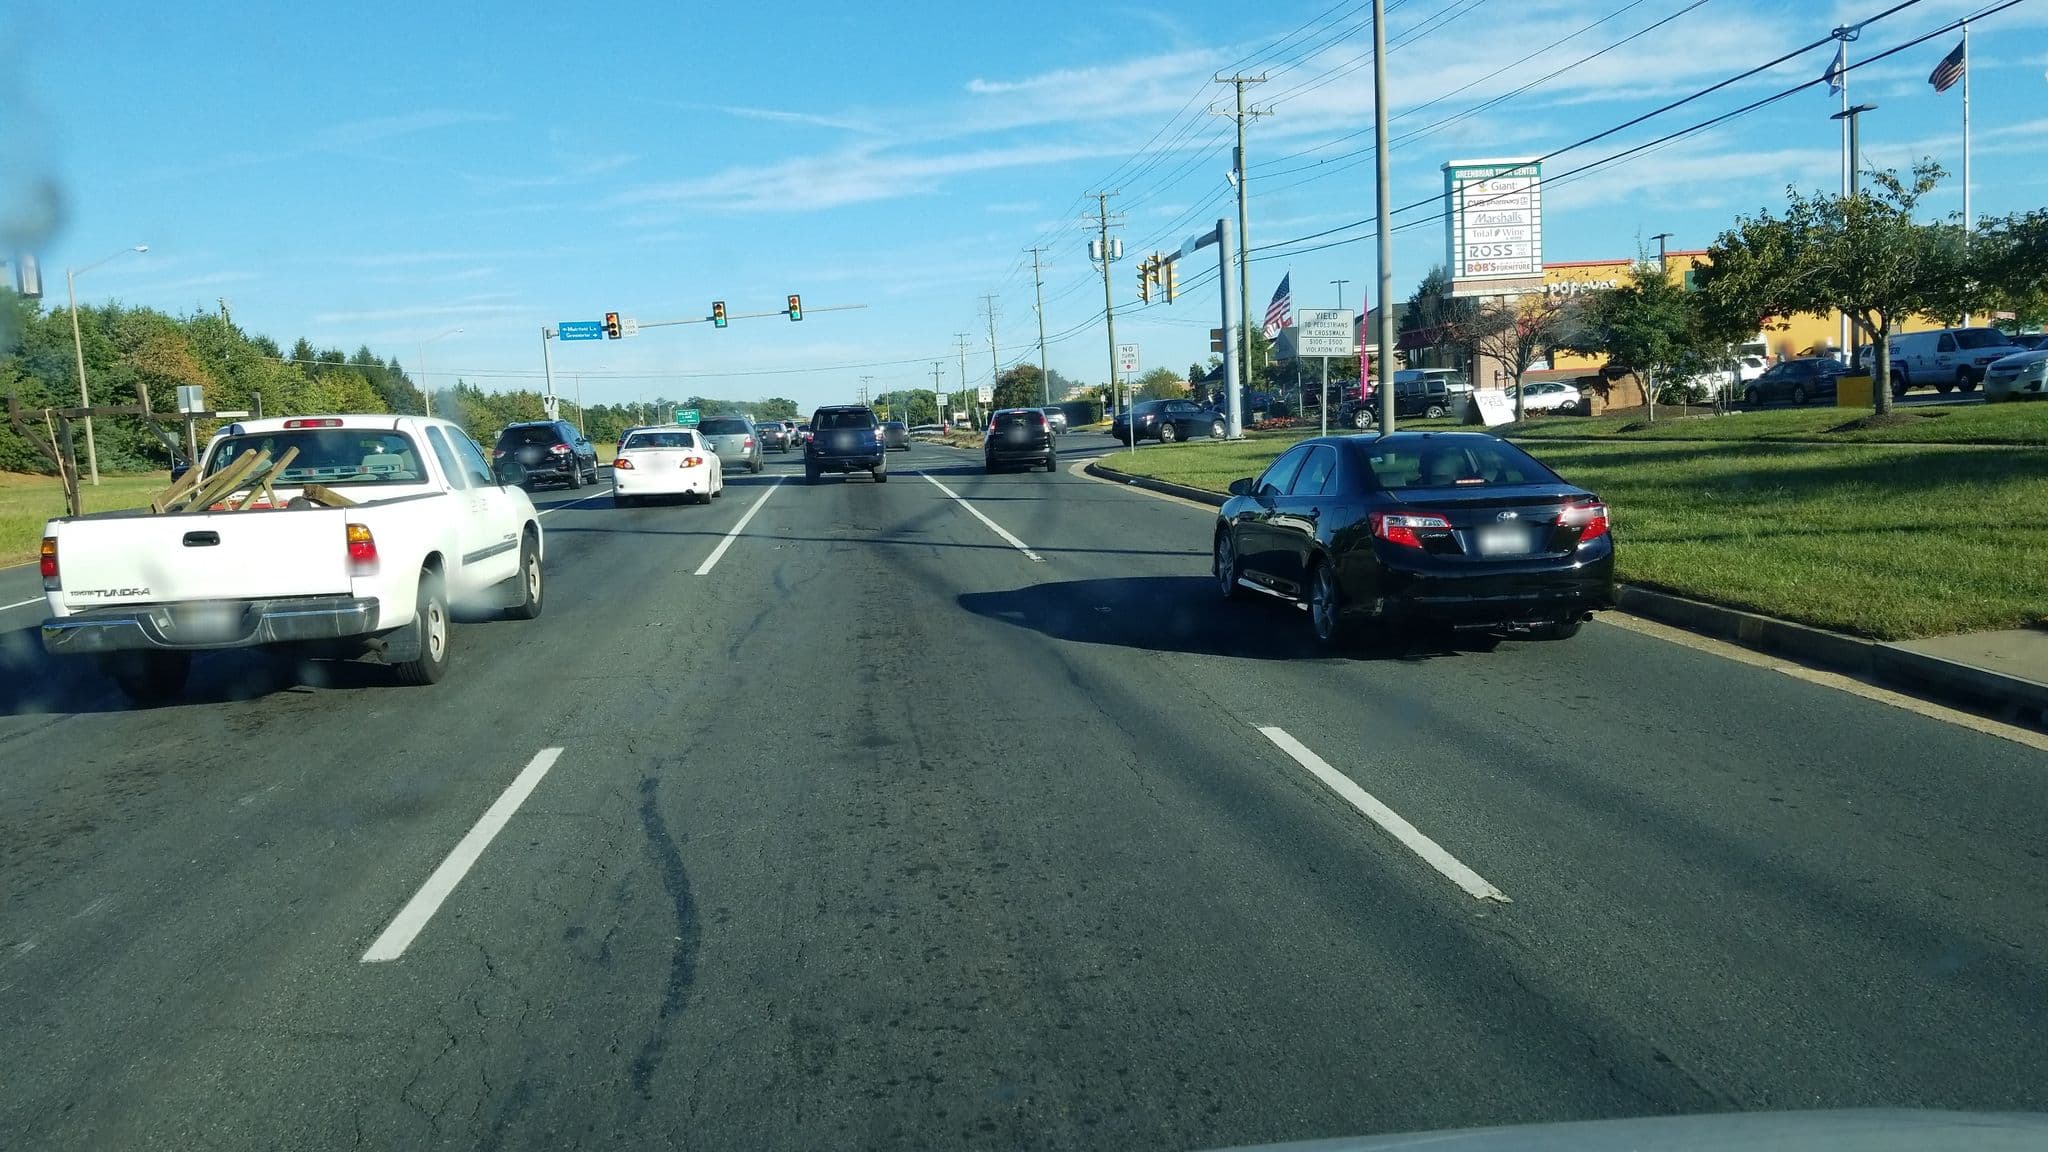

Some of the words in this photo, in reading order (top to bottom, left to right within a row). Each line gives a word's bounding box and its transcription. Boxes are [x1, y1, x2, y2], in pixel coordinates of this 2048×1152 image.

[1455, 168, 1494, 178] GREENBRIAR
[1514, 166, 1538, 176] CENTER
[1491, 182, 1516, 191] Giant
[1467, 199, 1486, 207] CVS
[1487, 198, 1519, 207] pharmacy
[1475, 212, 1522, 224] Marshalls
[1472, 229, 1493, 238] Total
[1502, 228, 1524, 237] Wine
[1469, 244, 1512, 258] ROSS
[1467, 262, 1496, 273] BOB'S
[1496, 263, 1531, 272] FURNITURE
[1315, 312, 1338, 320] YIELD
[95, 587, 151, 597] TUNDRA
